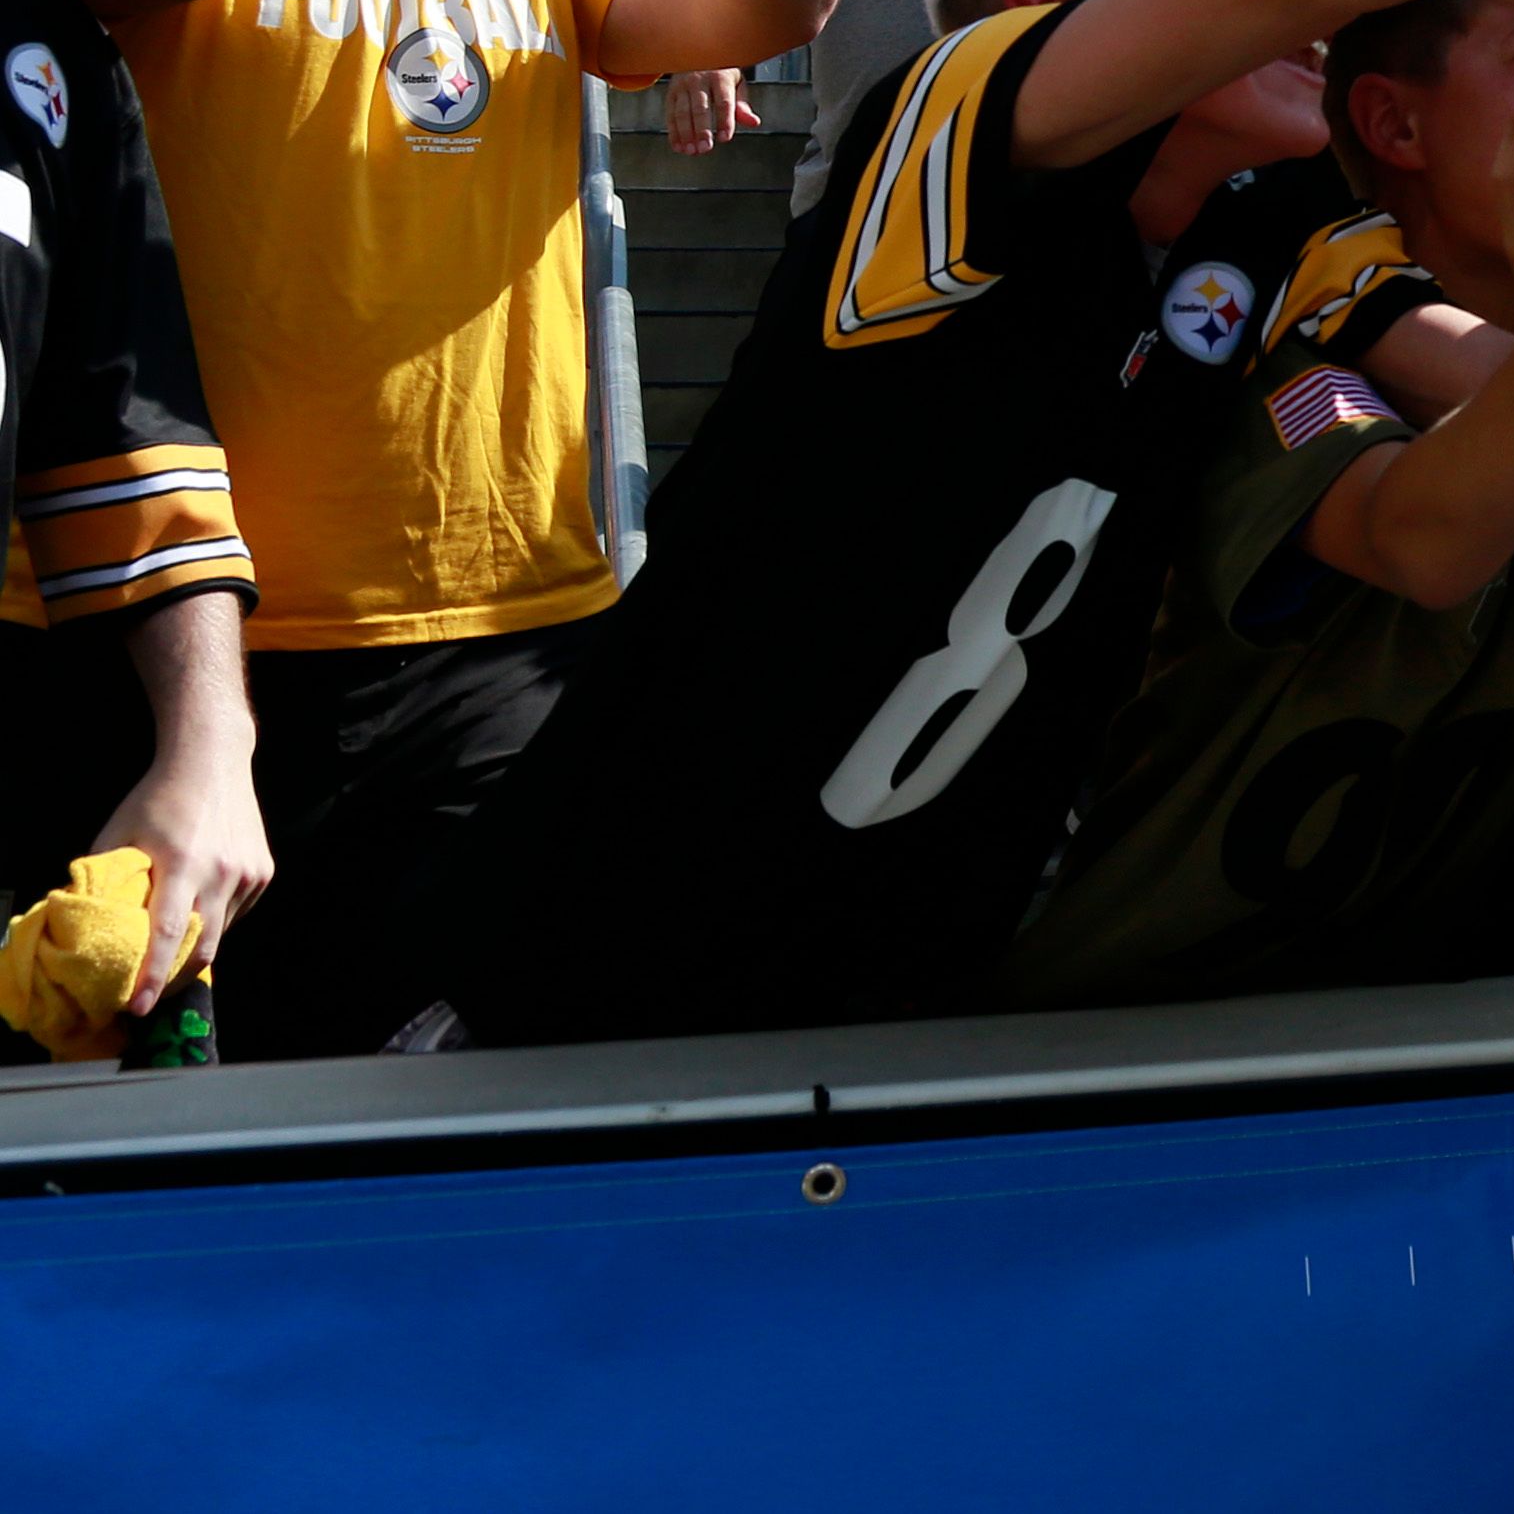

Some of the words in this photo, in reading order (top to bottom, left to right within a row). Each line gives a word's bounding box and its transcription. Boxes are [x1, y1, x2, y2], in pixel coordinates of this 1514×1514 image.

[401, 72, 439, 85] Steelers
[404, 135, 483, 145] PITTSBURGH
[1171, 301, 1209, 315] Steelers
[819, 476, 1118, 831] 8
